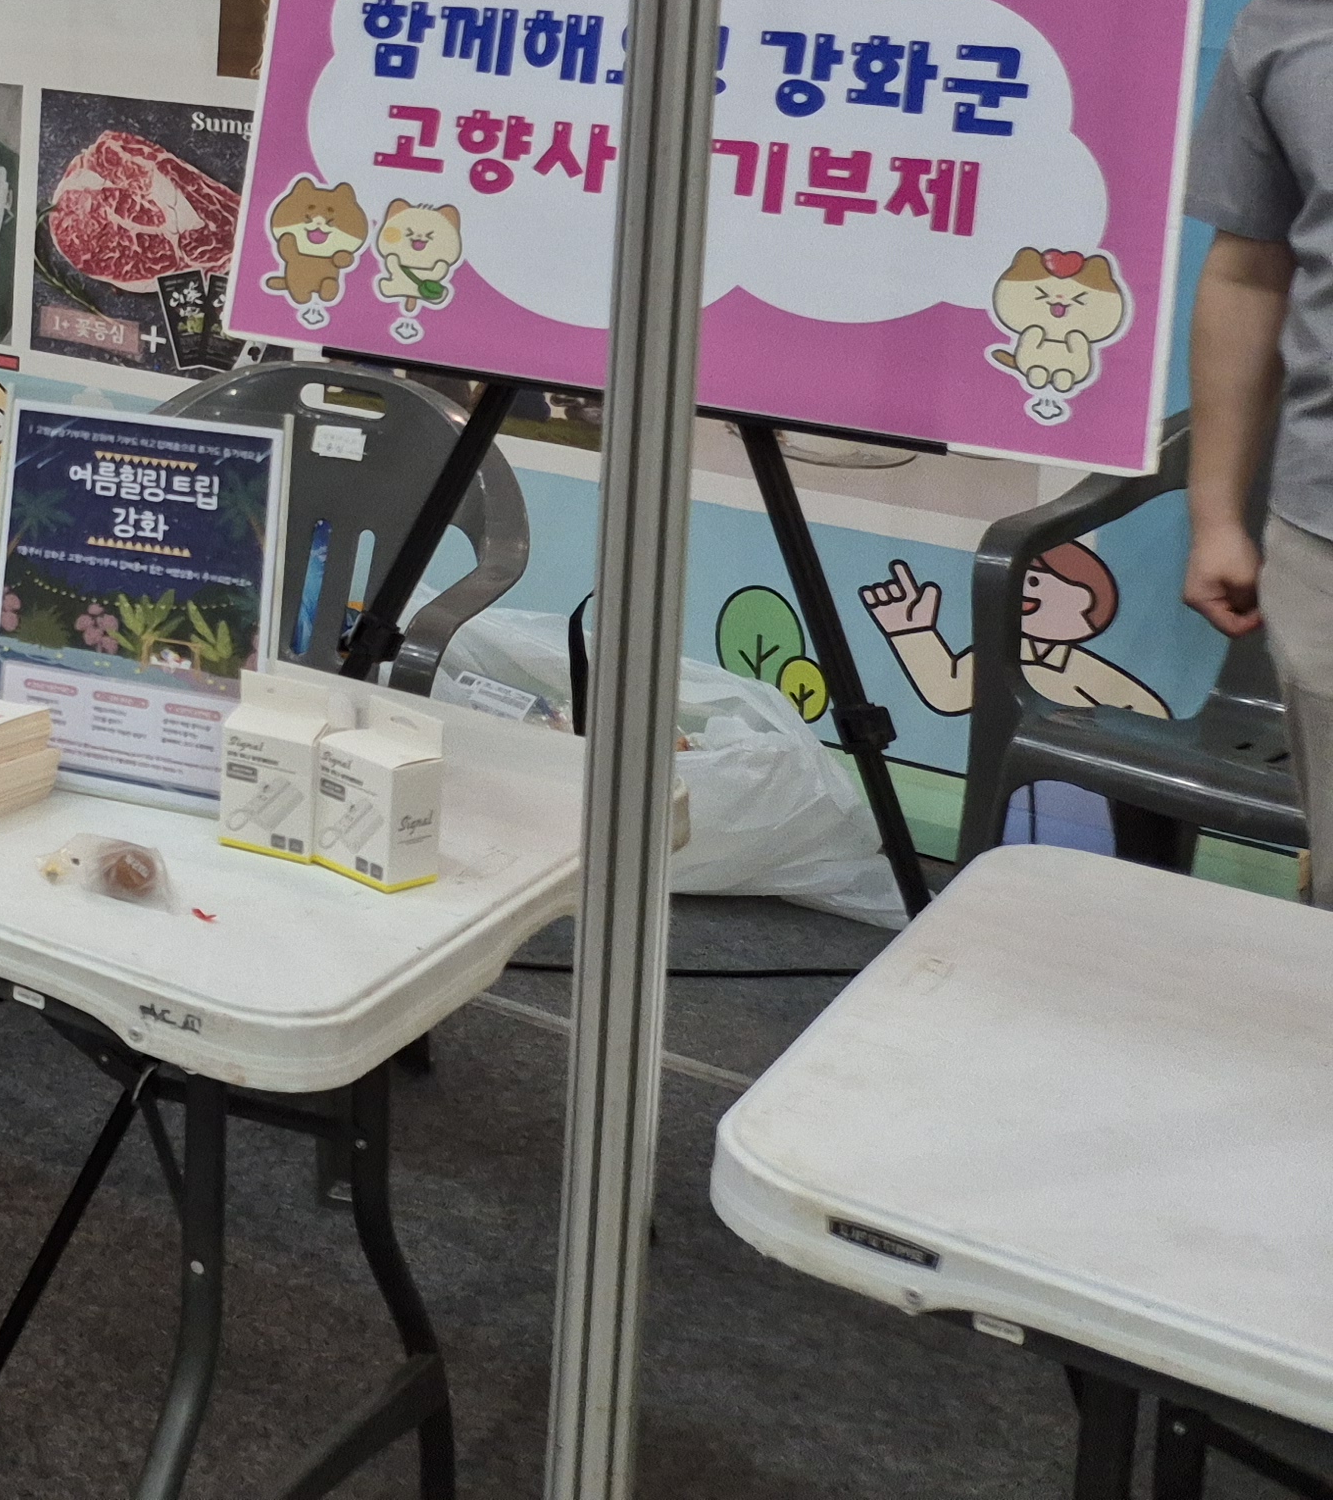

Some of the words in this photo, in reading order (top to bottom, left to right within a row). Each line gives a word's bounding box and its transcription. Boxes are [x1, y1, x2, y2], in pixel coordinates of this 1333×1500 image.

[760, 26, 1030, 137] 강화군
[372, 103, 982, 238] 고향사기부제
[75, 318, 126, 345] 꽃등심
[113, 507, 169, 541] 강화
[227, 735, 265, 755] Signal
